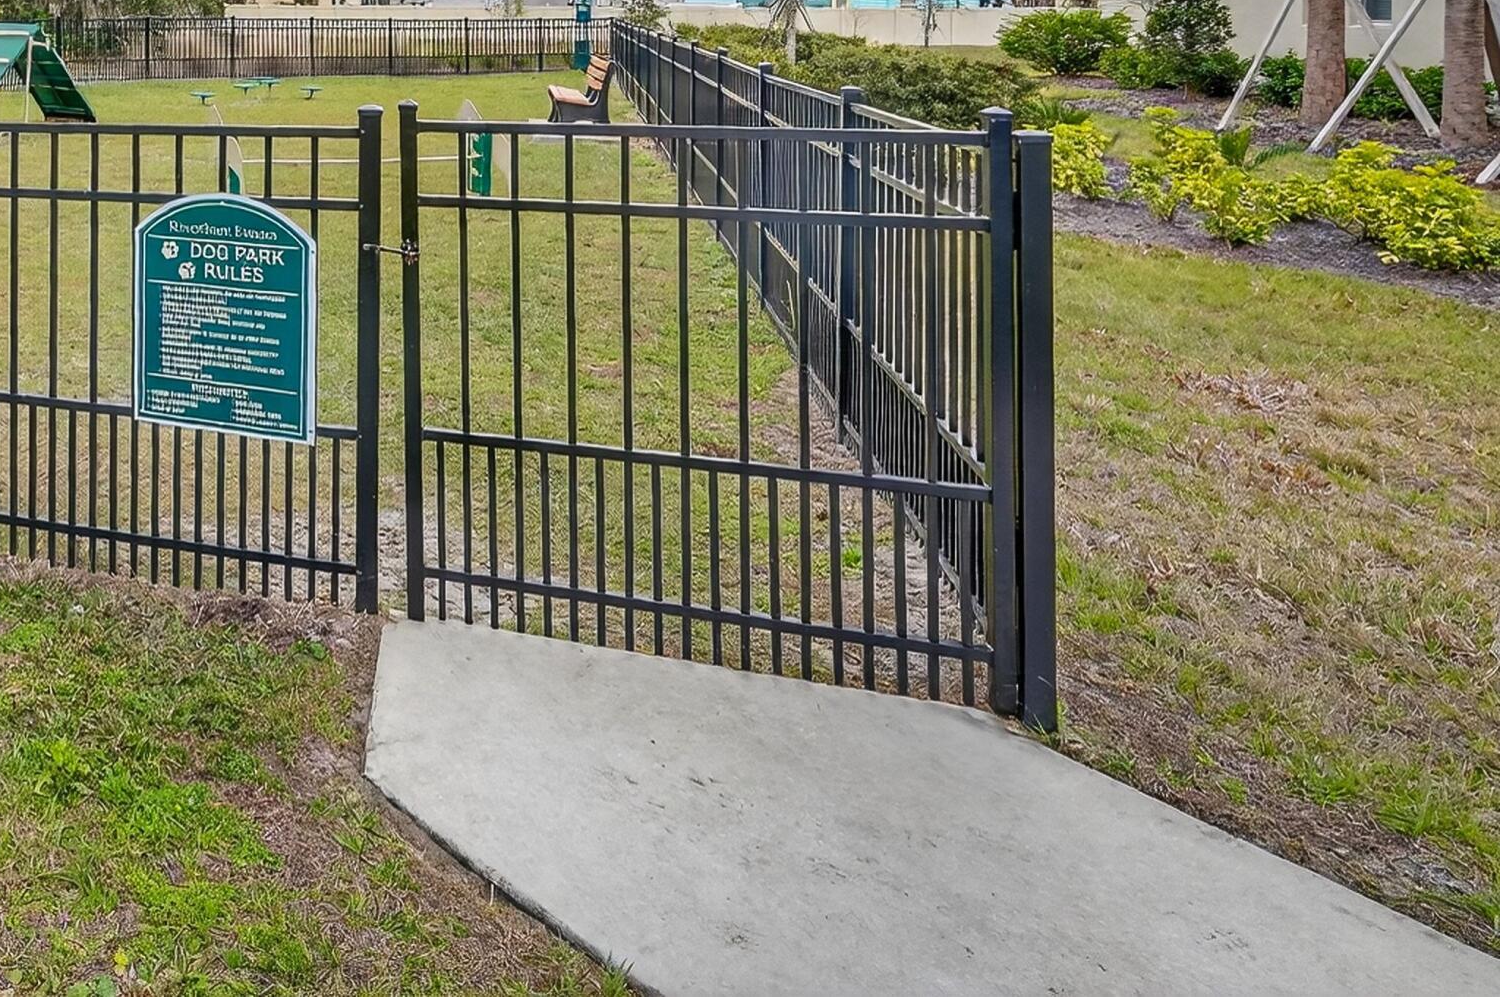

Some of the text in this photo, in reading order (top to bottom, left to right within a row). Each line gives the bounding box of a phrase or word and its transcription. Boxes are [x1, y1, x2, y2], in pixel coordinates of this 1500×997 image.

[190, 242, 285, 266] DOG PARK
[204, 262, 264, 283] RULES
